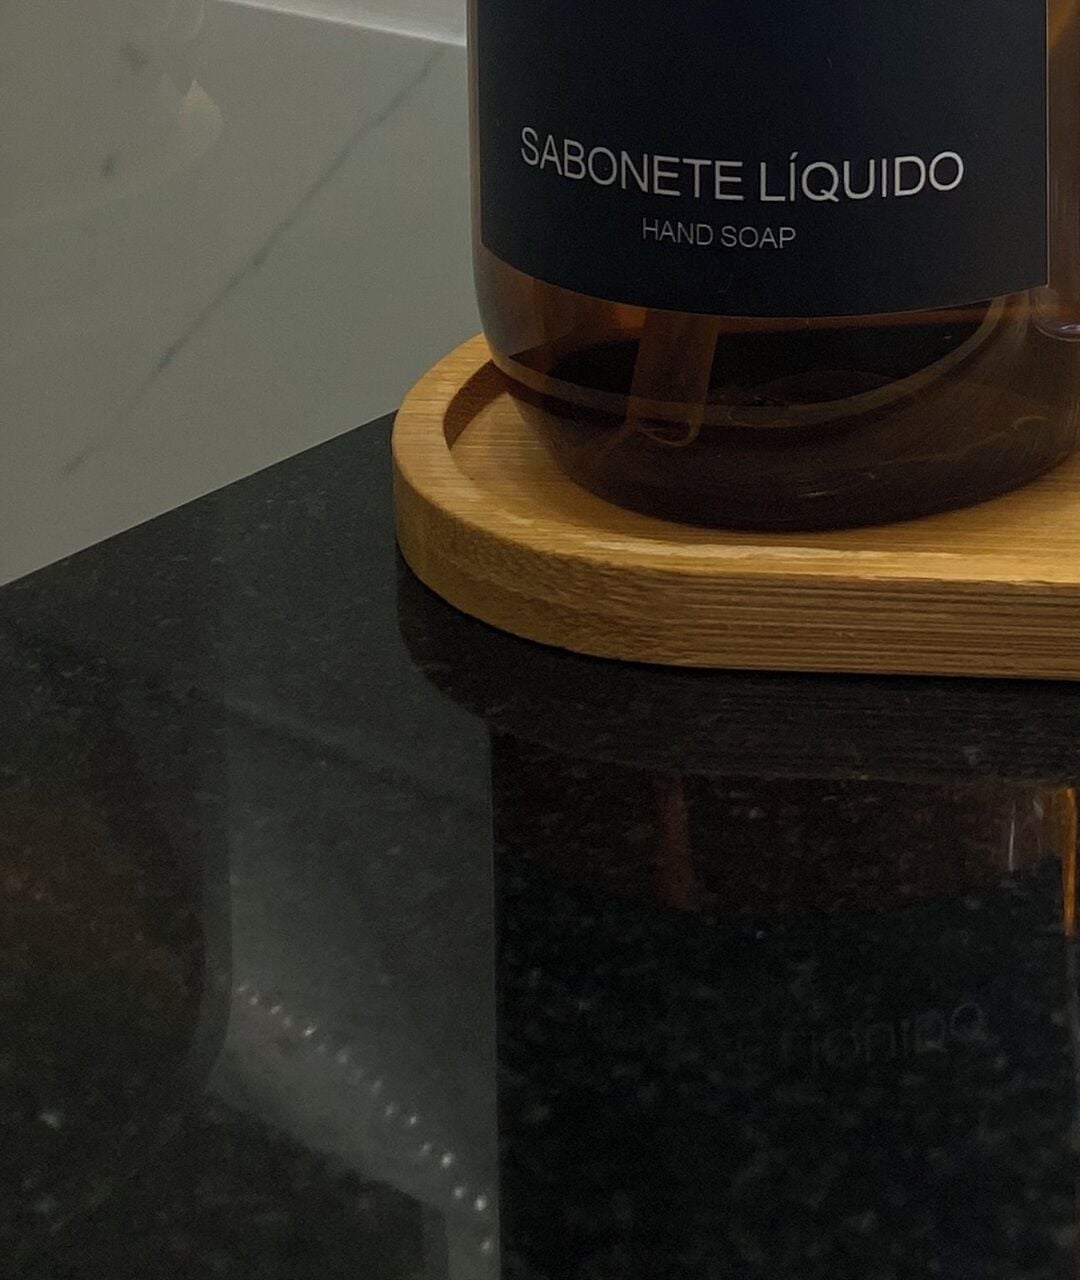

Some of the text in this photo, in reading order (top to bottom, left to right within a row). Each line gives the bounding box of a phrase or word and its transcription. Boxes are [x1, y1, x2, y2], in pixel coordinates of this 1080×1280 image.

[520, 126, 965, 203] SABONETE LÍQUIDO
[641, 217, 797, 251] HAND SOAP
